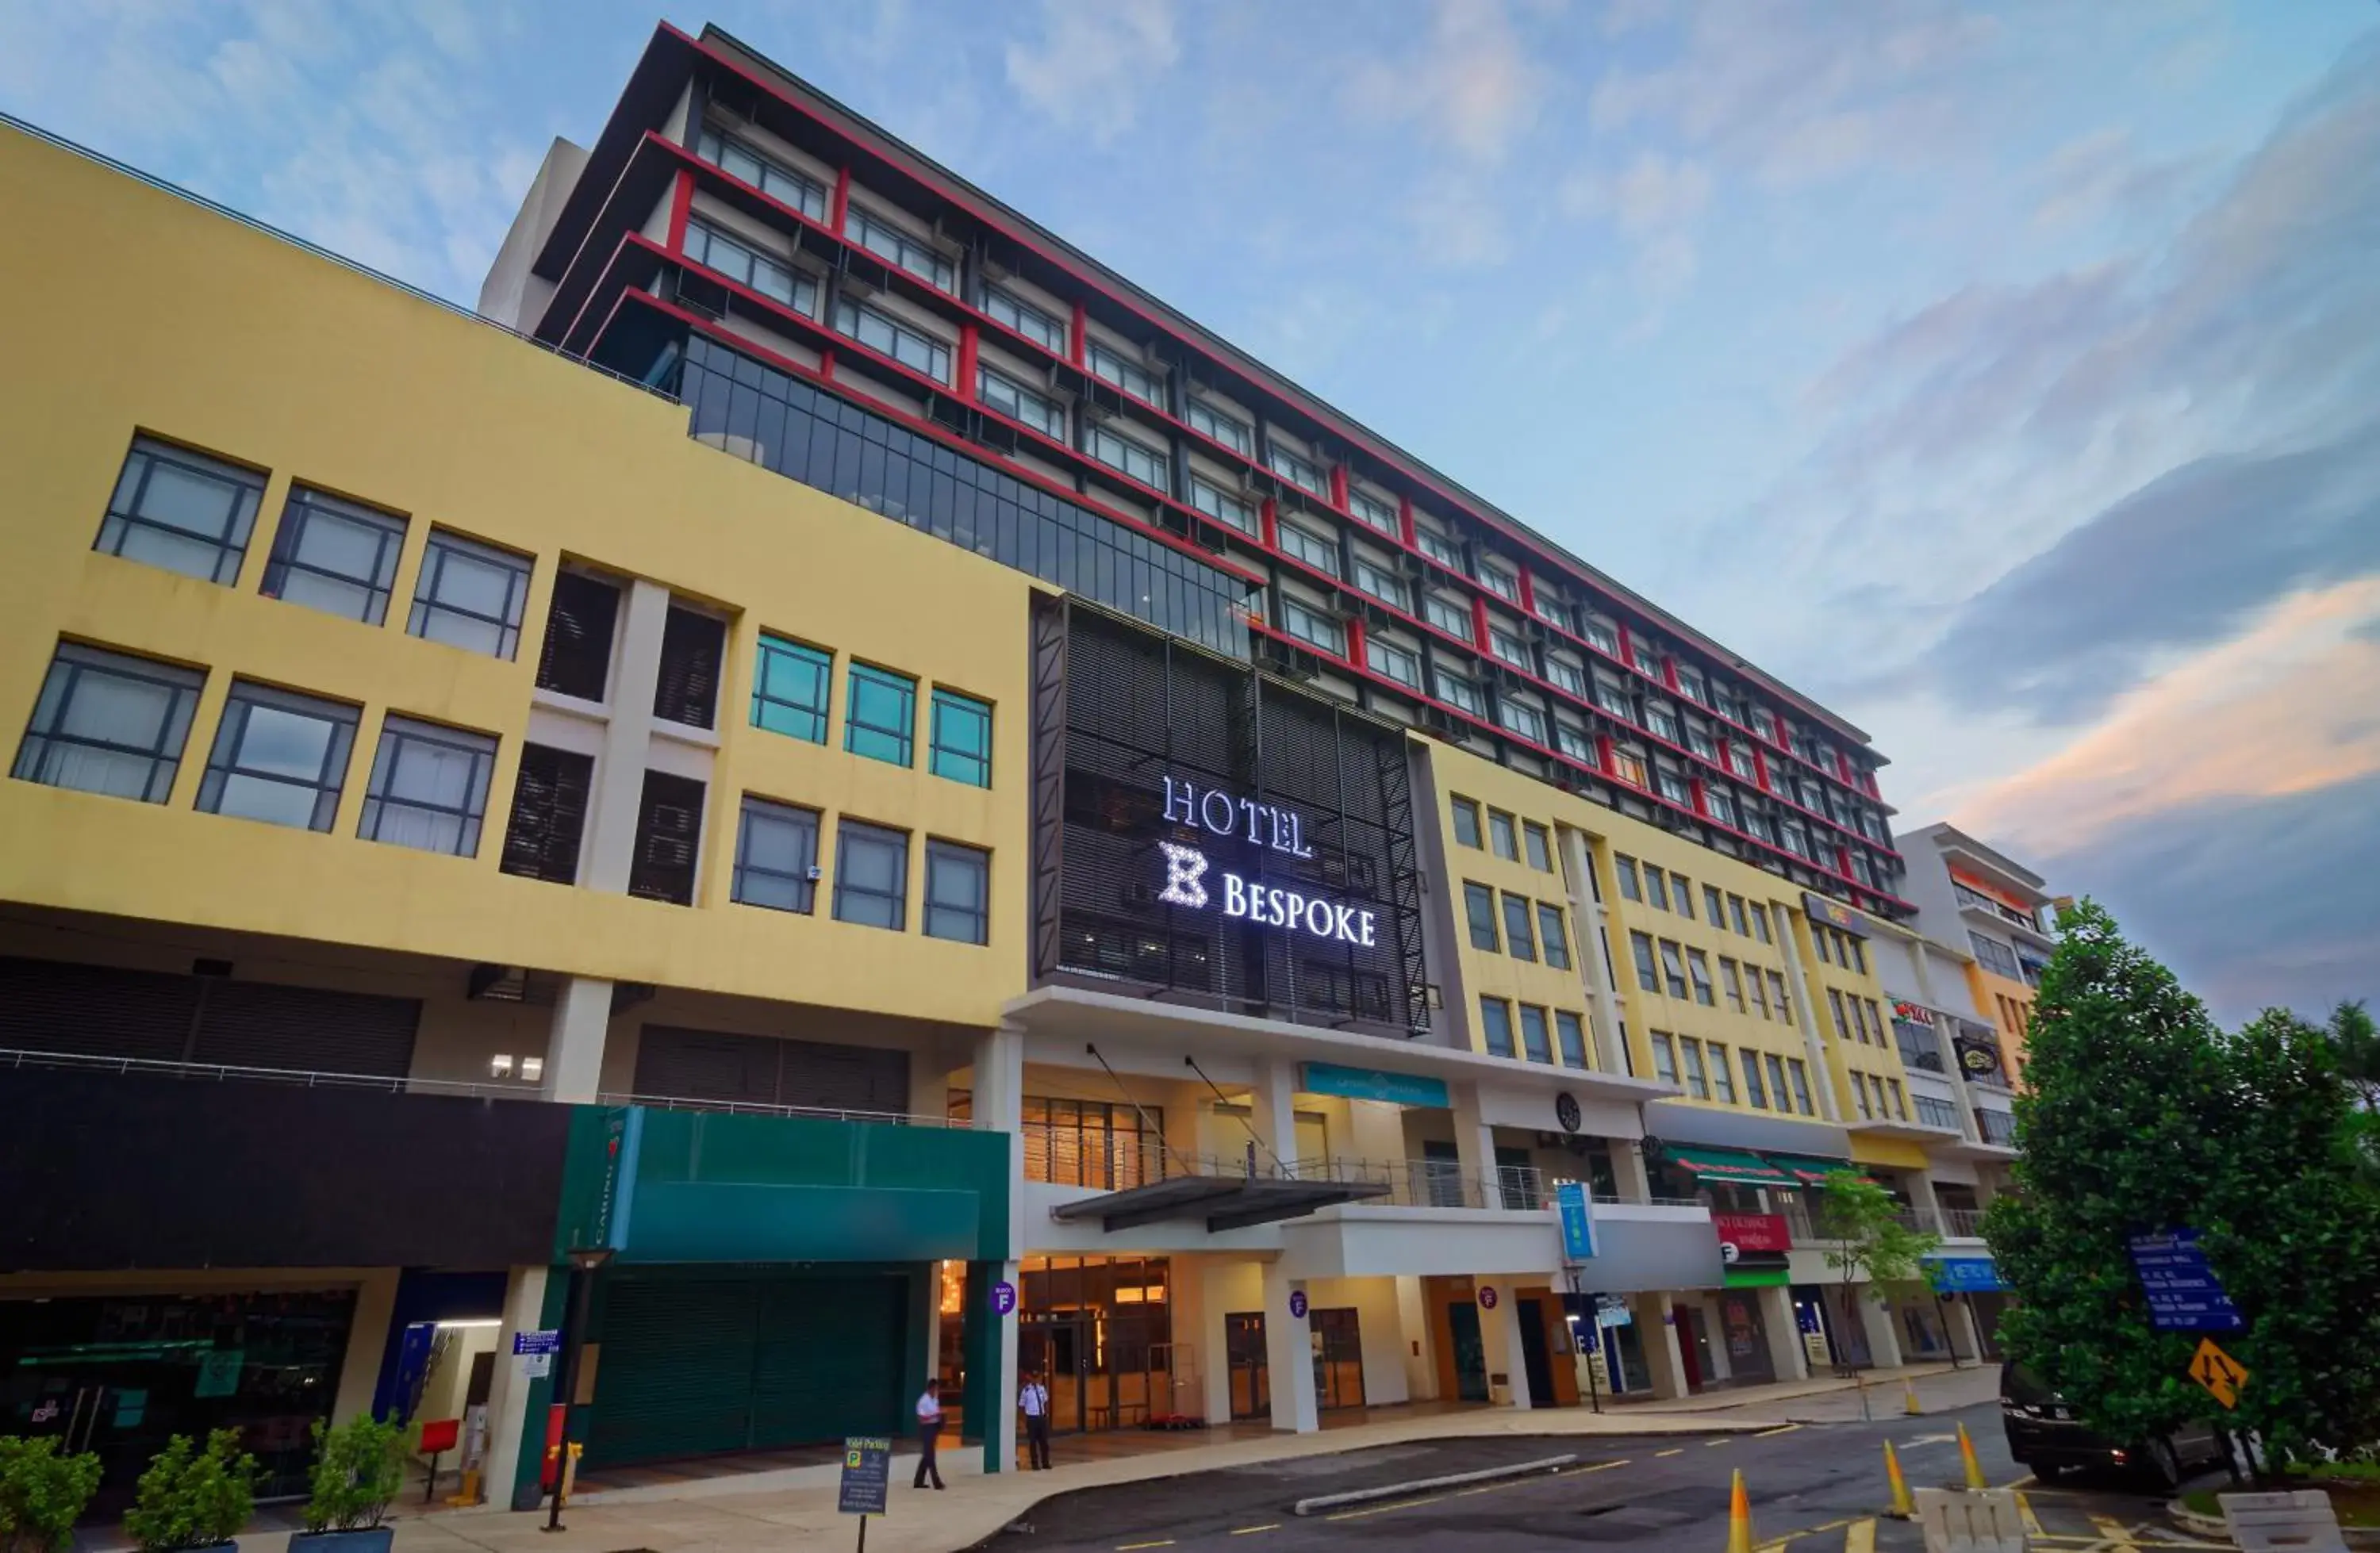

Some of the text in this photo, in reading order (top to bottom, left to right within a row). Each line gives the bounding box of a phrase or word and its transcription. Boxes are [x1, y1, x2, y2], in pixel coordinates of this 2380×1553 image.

[1163, 776, 1313, 857] HOTEL
[1721, 1246, 1732, 1260] F
[1000, 1294, 1009, 1310] F
[1296, 1301, 1303, 1314] F
